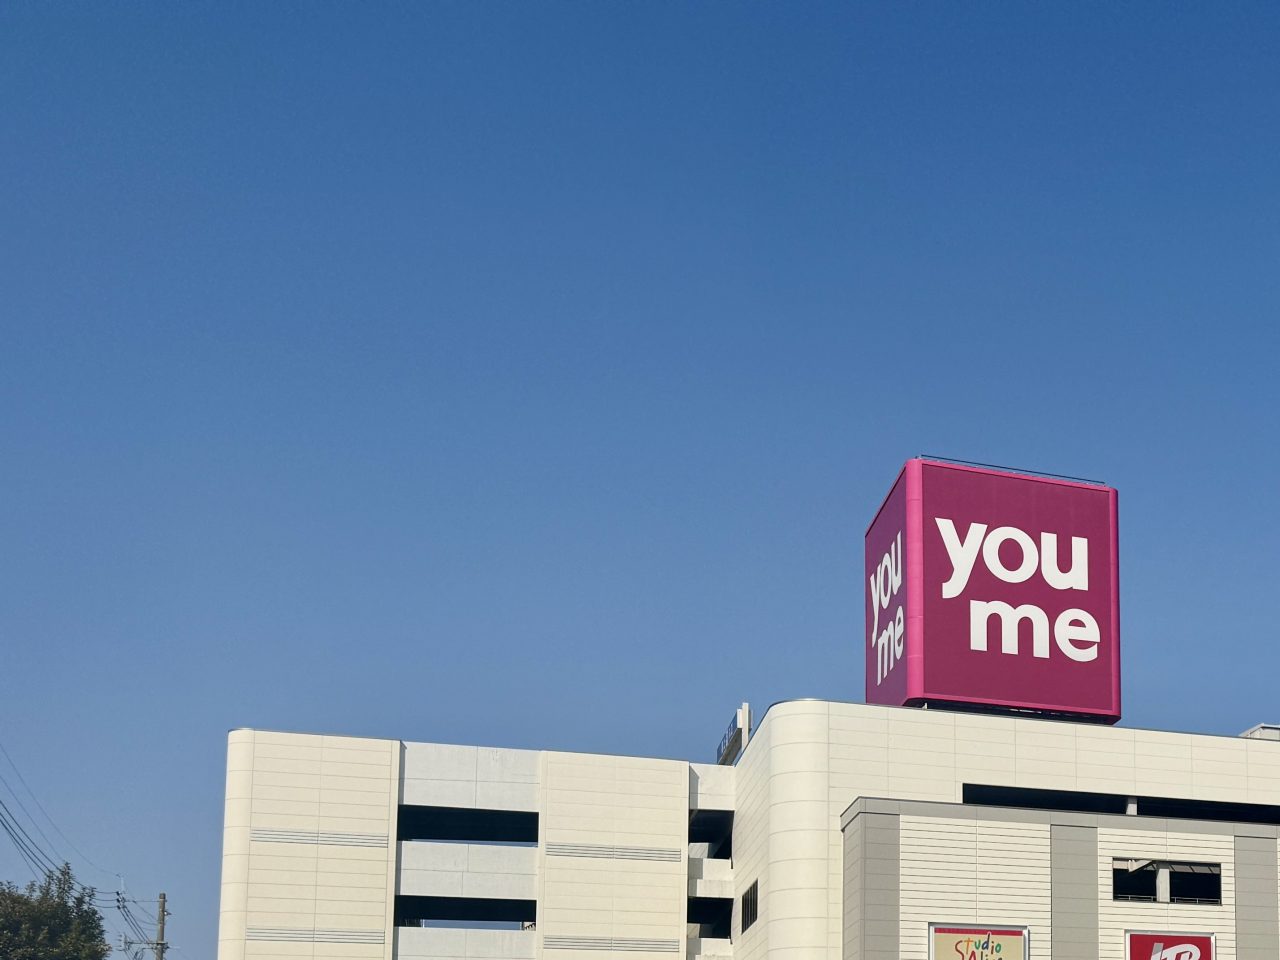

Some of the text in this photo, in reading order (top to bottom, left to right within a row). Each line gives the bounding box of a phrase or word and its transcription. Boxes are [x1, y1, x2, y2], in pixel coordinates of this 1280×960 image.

[870, 530, 902, 648] you
[934, 516, 1089, 599] you
[877, 605, 904, 686] me
[969, 599, 1101, 662] me
